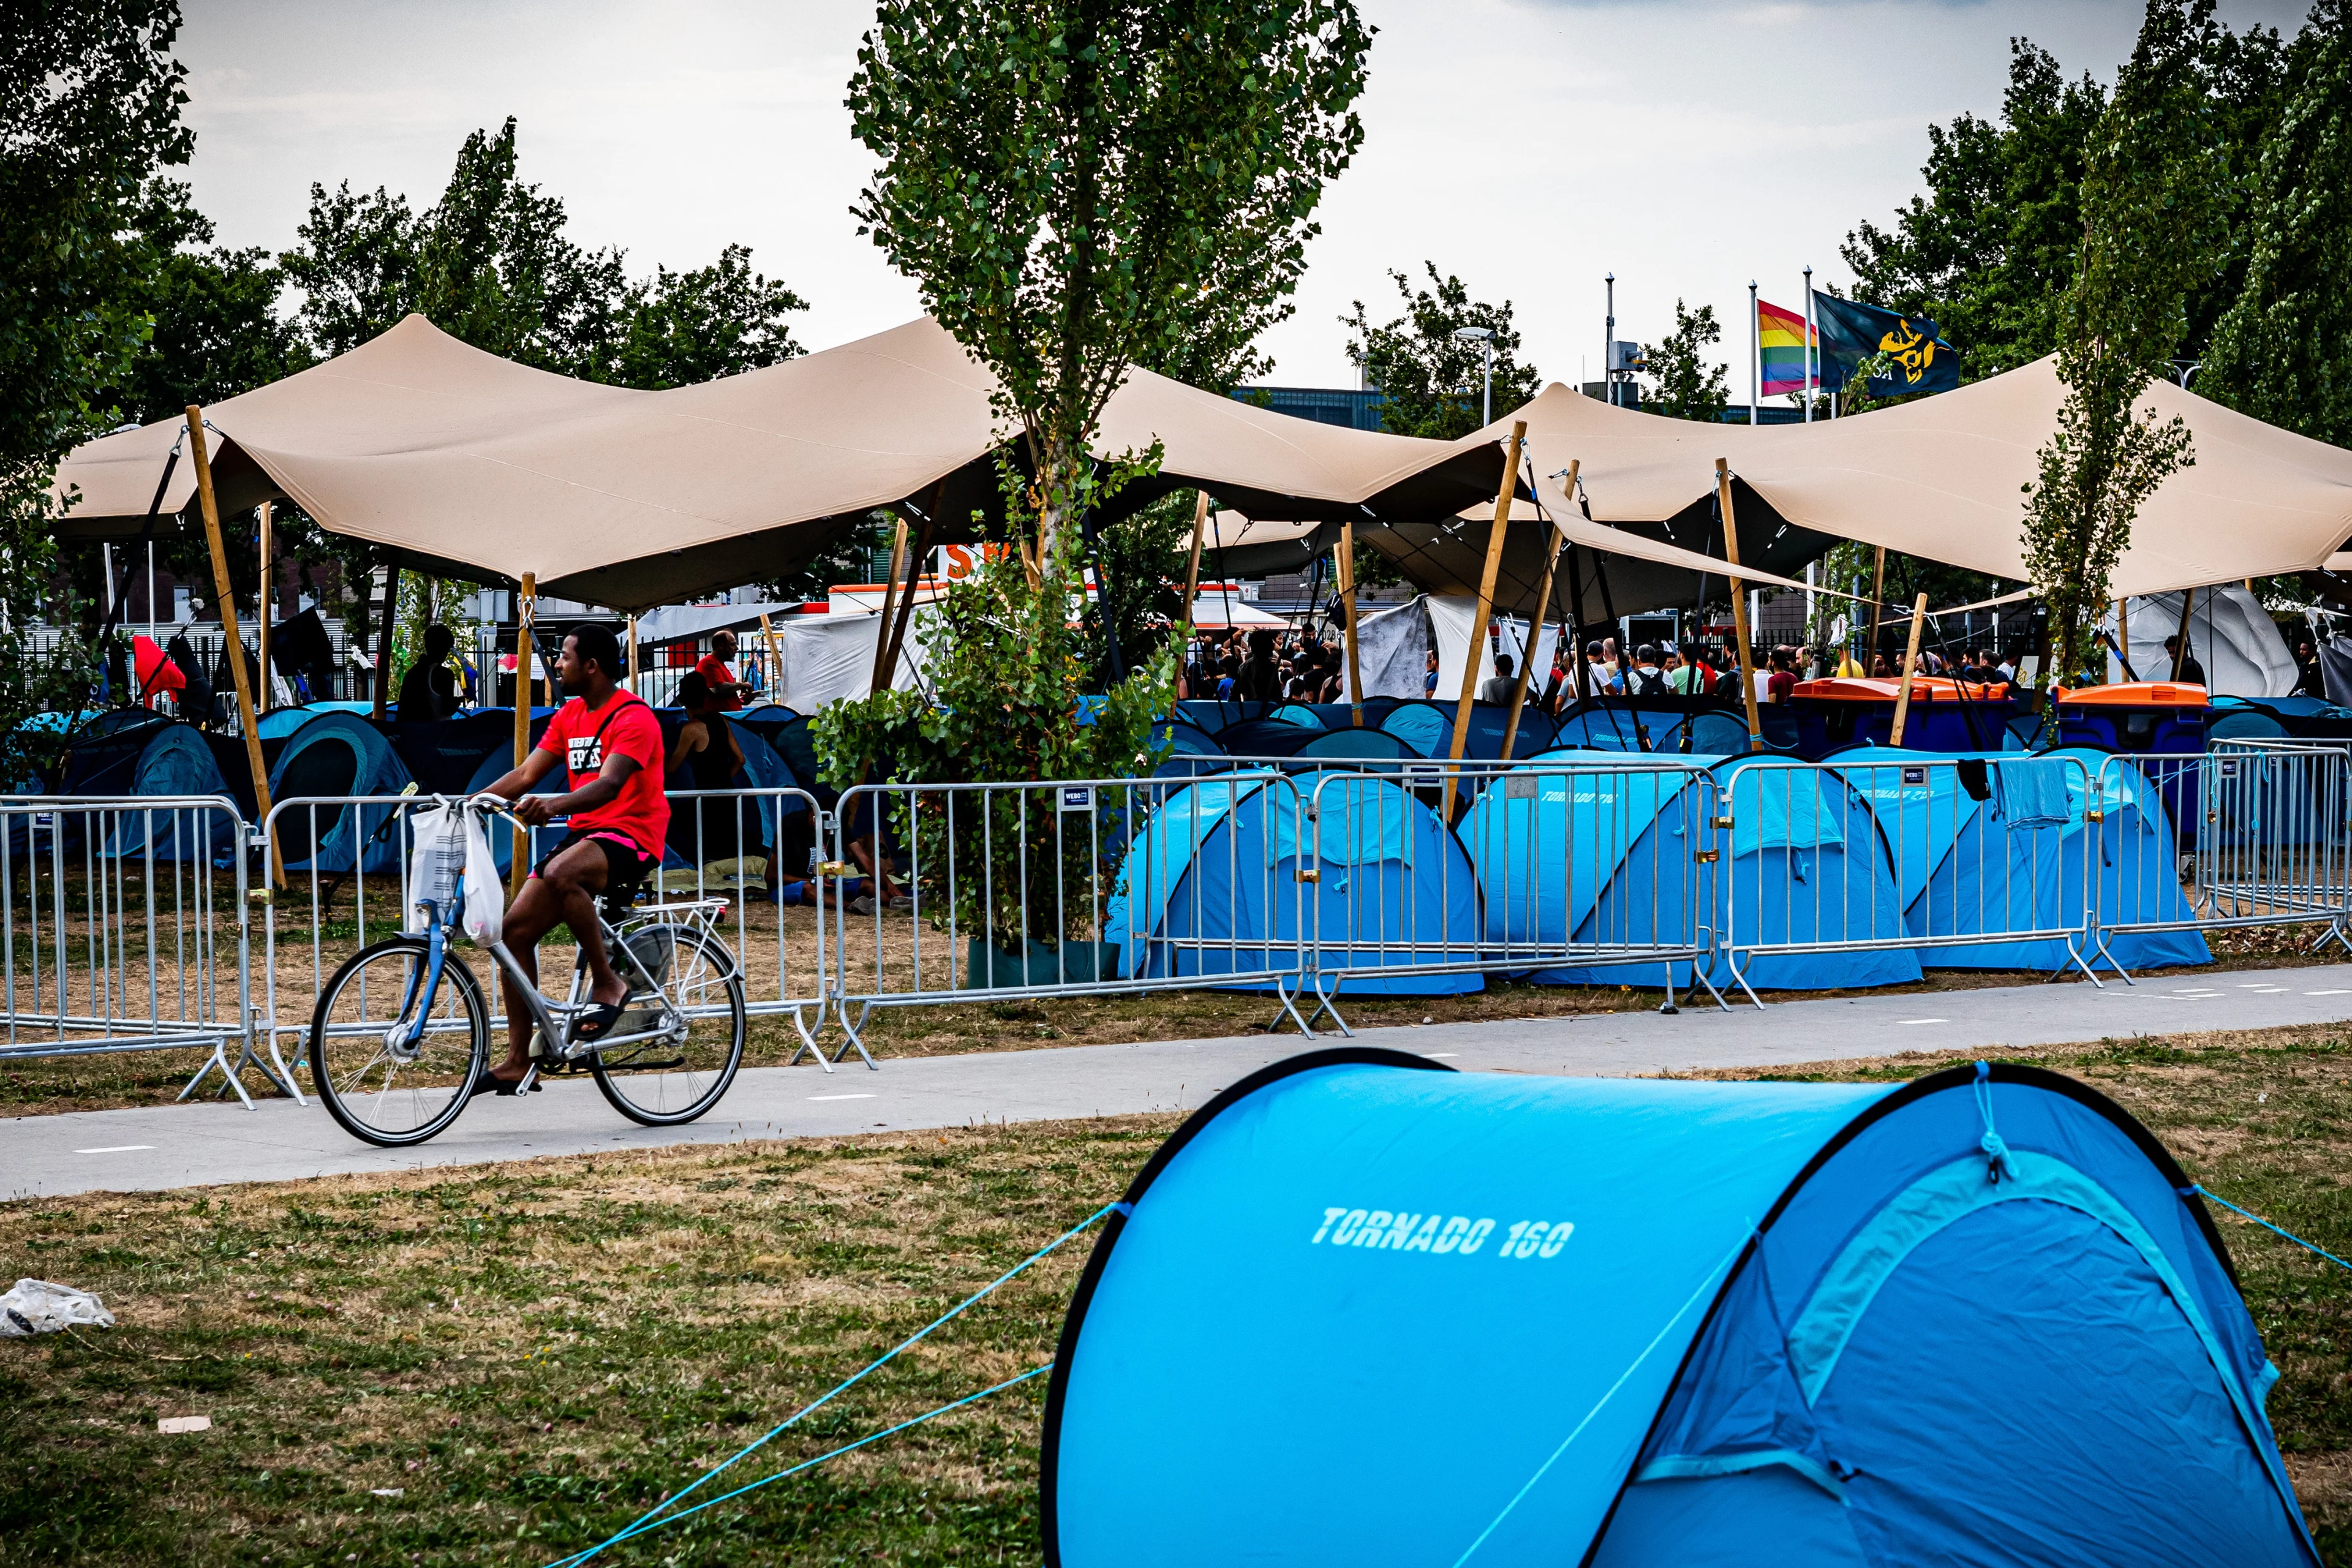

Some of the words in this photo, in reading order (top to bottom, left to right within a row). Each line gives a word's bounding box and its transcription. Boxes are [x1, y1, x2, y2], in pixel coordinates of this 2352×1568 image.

[1541, 791, 1596, 803] TORNADO
[1311, 1207, 1496, 1255] TORNADO
[1498, 1219, 1576, 1259] 160
